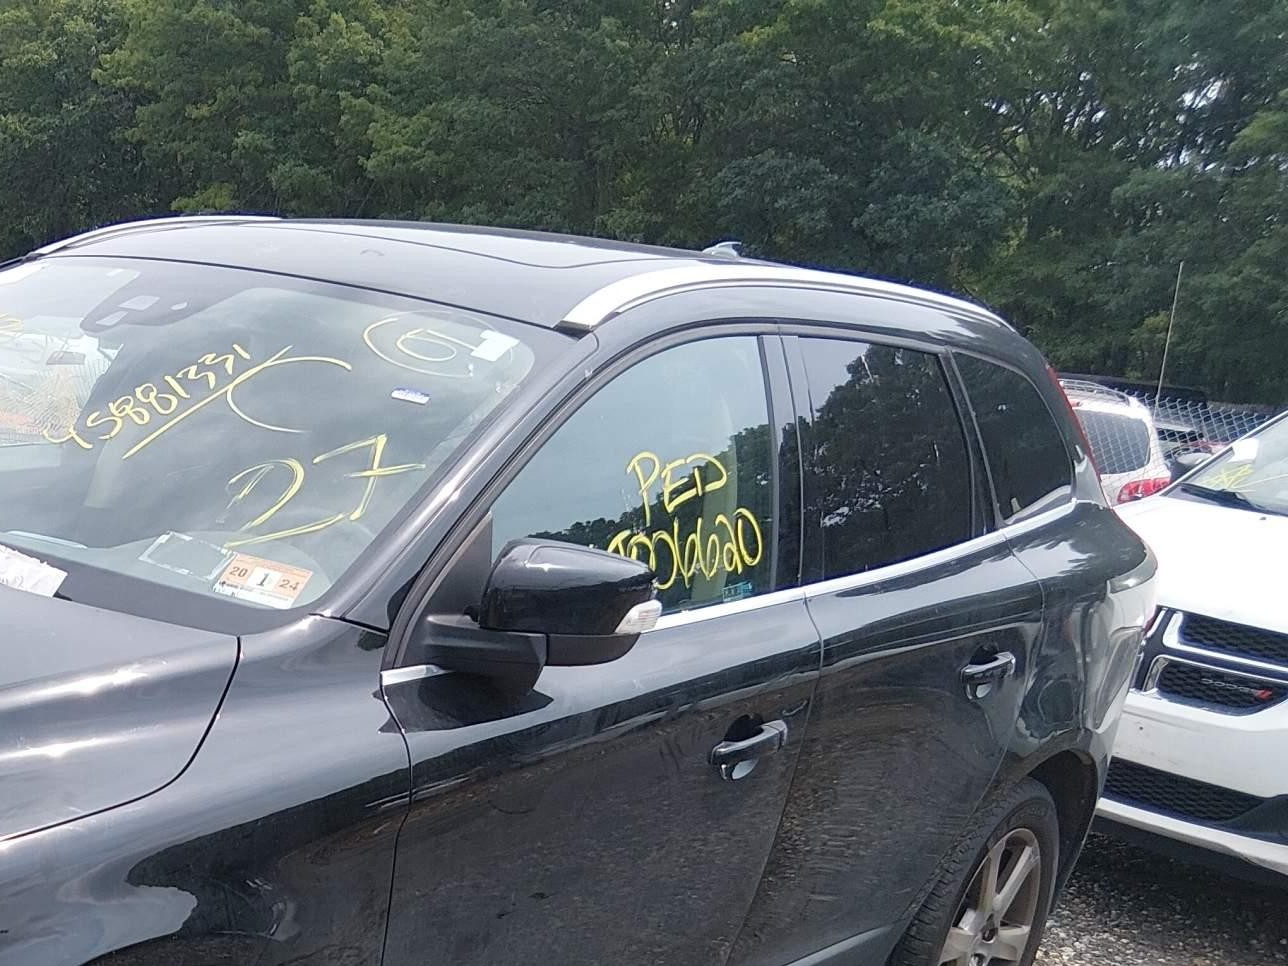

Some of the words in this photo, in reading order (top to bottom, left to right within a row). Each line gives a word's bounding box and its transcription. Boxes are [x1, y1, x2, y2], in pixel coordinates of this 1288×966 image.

[40, 342, 253, 450] 45881331
[626, 451, 728, 527] PED
[229, 566, 248, 578] 20
[256, 572, 270, 587] 1
[279, 578, 300, 591] 24
